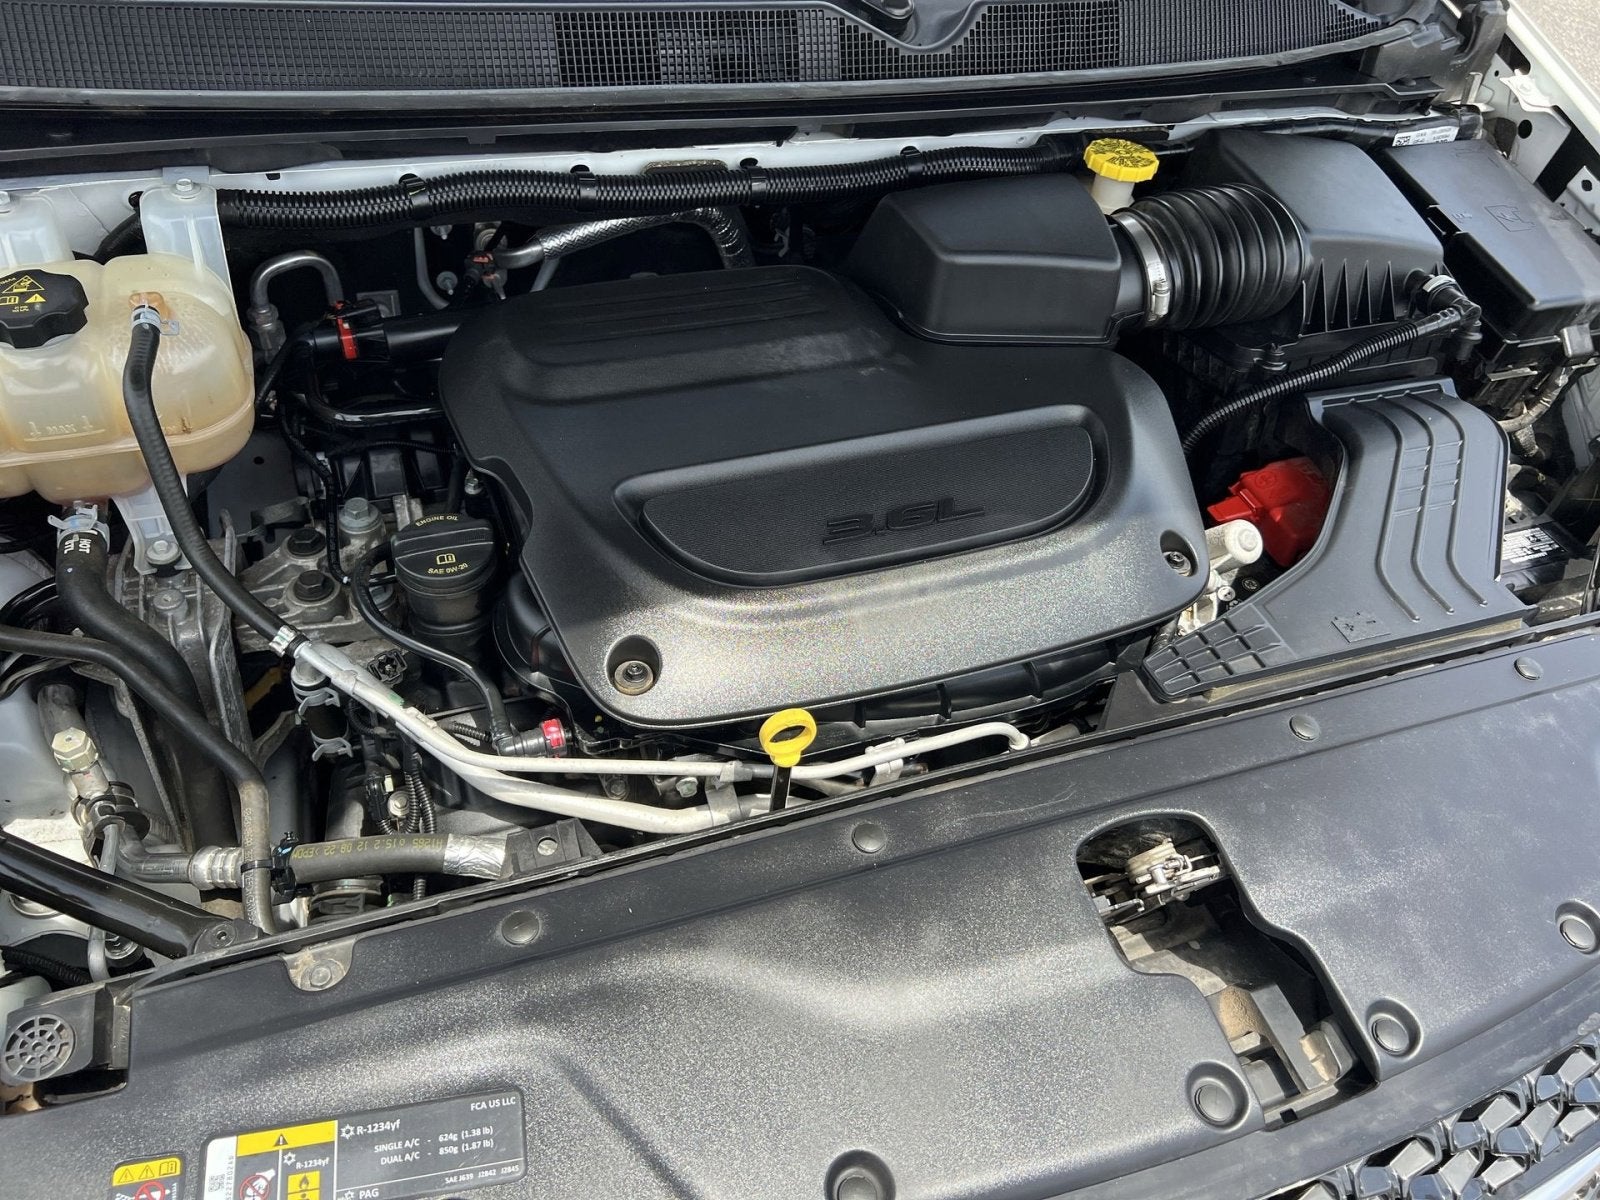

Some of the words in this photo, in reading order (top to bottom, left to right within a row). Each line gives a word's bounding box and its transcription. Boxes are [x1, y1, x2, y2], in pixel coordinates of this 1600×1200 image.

[415, 515, 445, 527] ENGINE
[822, 496, 986, 545] 3.6L
[428, 567, 445, 575] SAE
[445, 562, 469, 574] 0W-20
[470, 1101, 487, 1111] FCA
[489, 1099, 500, 1109] US
[502, 1096, 516, 1106] LLC
[356, 1119, 401, 1135] R-1234yf
[374, 1141, 403, 1153] SINGLE
[404, 1138, 420, 1149] A/C
[438, 1132, 458, 1143] 624g
[461, 1127, 481, 1140] (1.38
[482, 1125, 494, 1135] lb)
[380, 1153, 403, 1165] DUAL
[405, 1150, 420, 1161] A/C
[438, 1145, 459, 1157] 850g
[461, 1139, 481, 1152] (1.87
[482, 1138, 494, 1149] lb)
[295, 1157, 330, 1170] R-1234yf
[445, 1175, 458, 1184] SAE
[458, 1172, 474, 1182] J639
[359, 1188, 380, 1200] PAG
